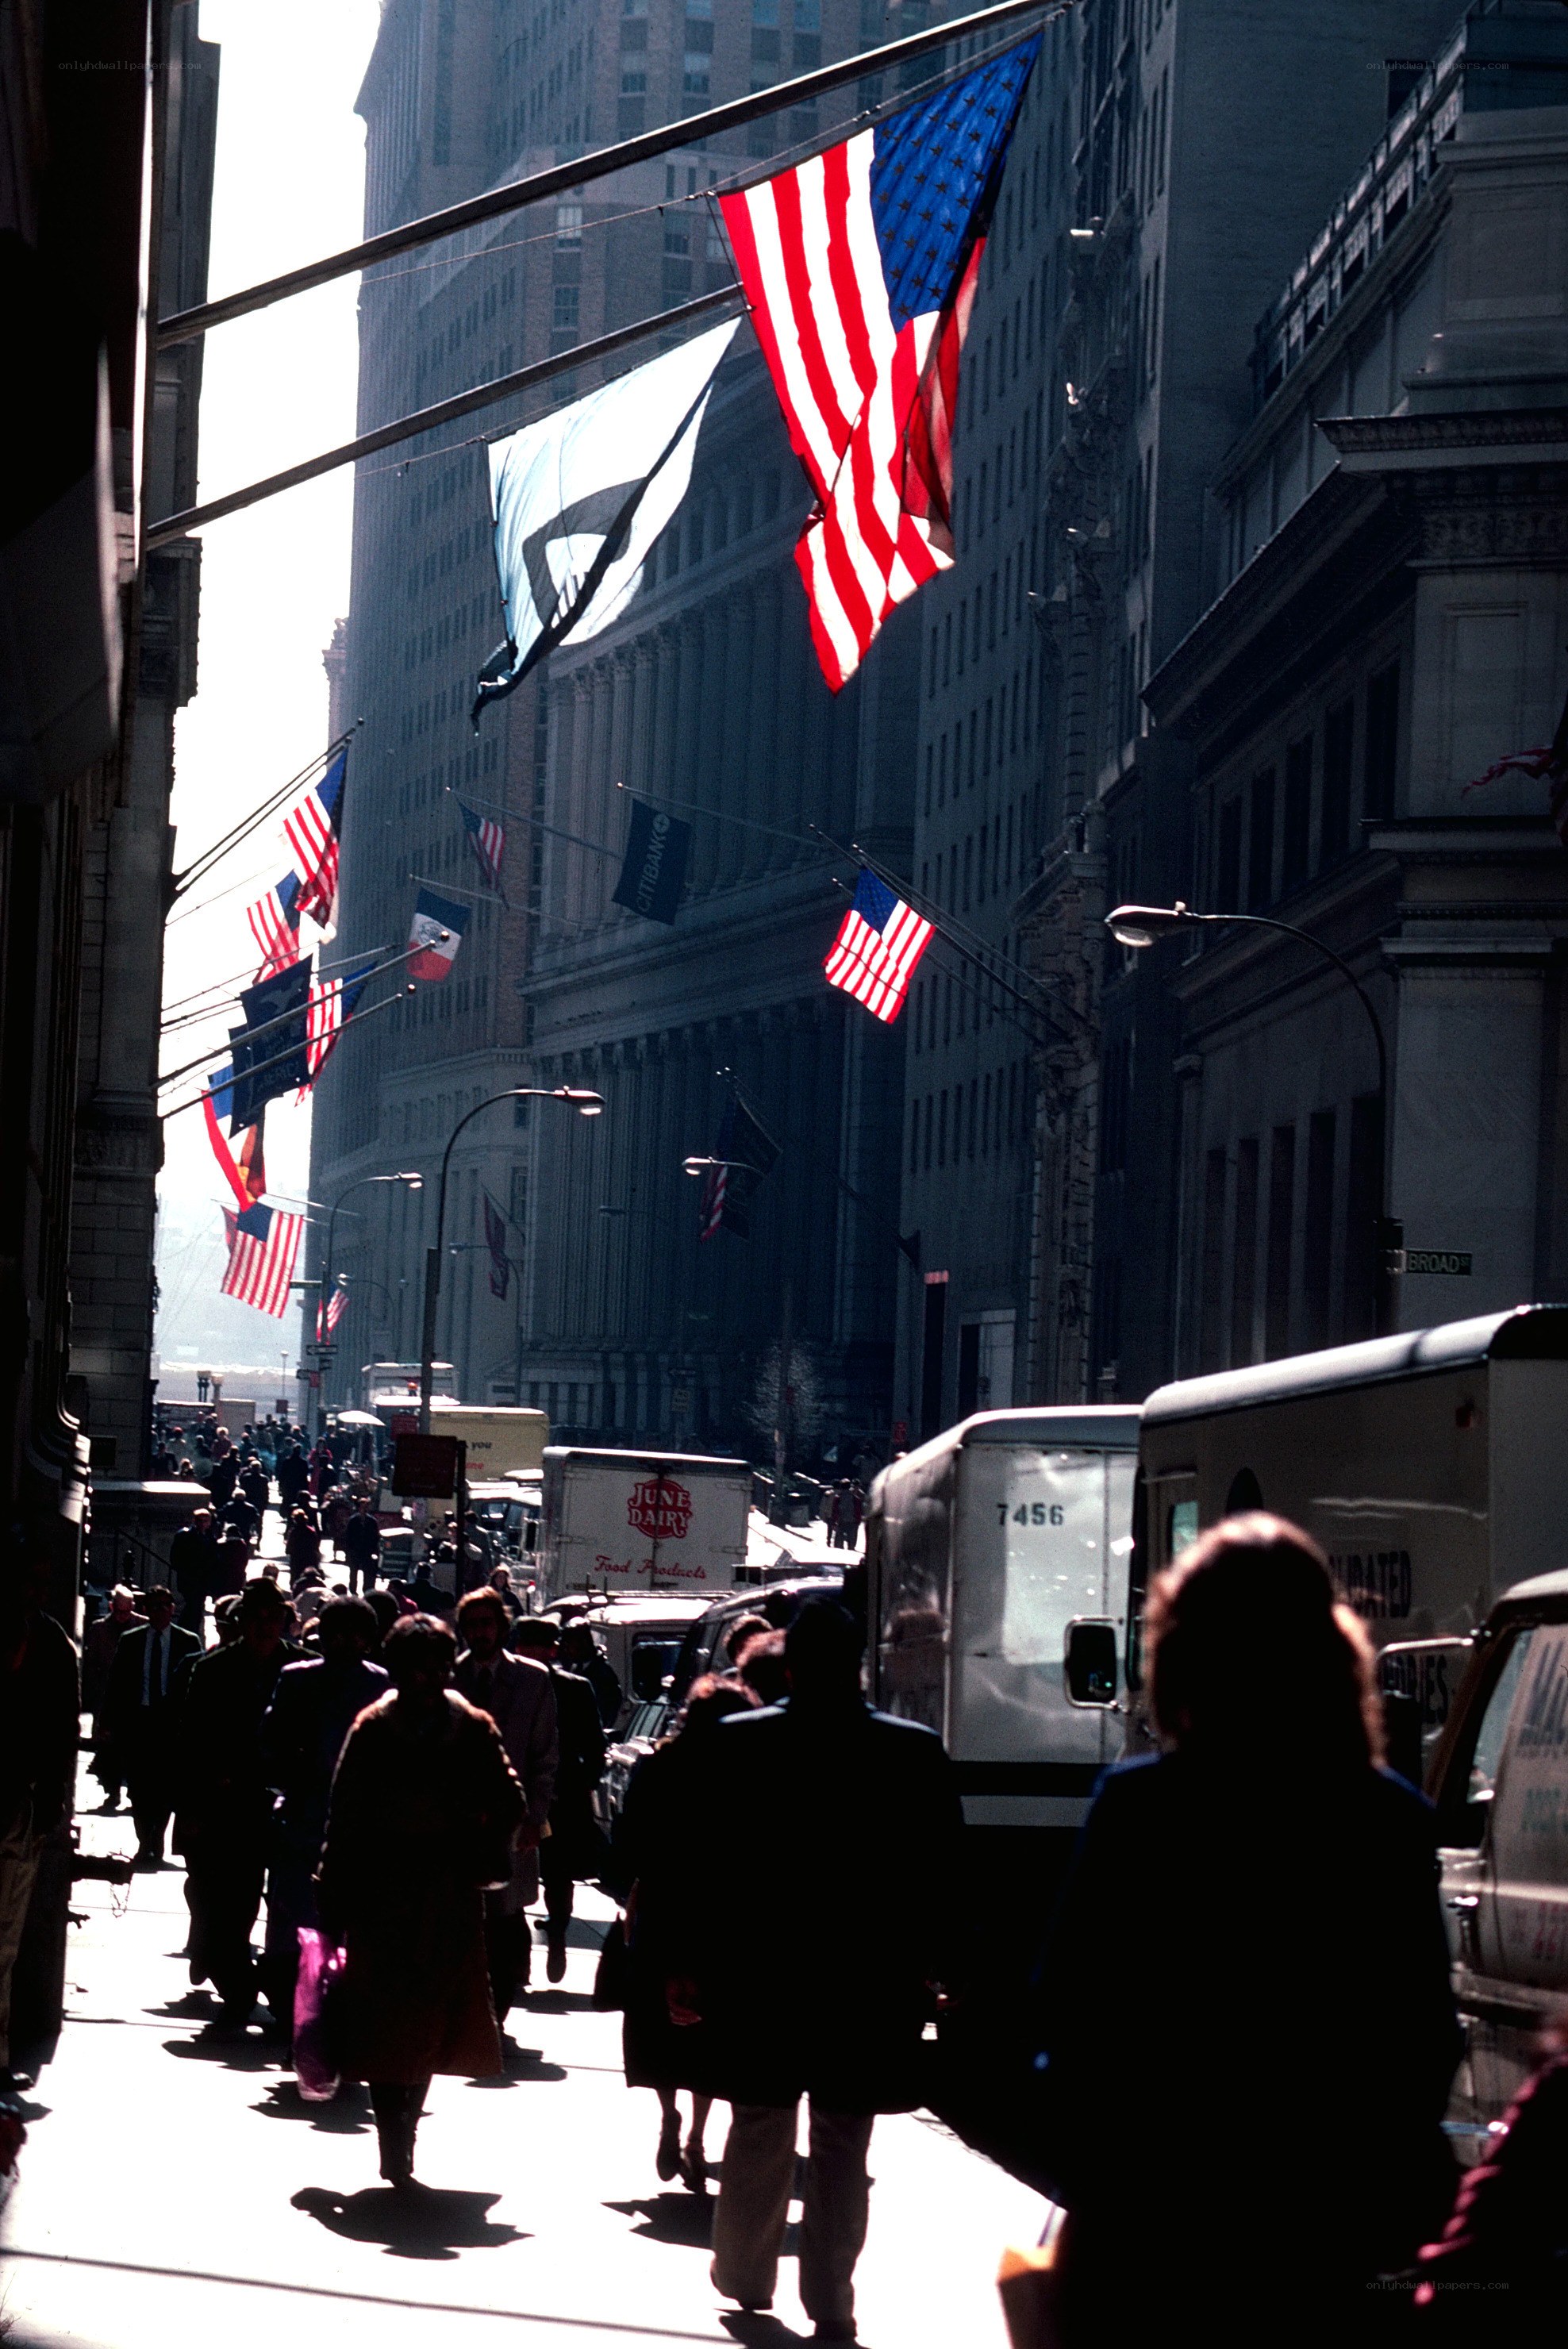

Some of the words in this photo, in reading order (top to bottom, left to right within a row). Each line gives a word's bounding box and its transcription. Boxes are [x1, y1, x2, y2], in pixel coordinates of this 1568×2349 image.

[636, 829, 667, 912] CITIBANK
[1409, 1253, 1460, 1273] BROAD
[628, 1483, 690, 1508] JUNE
[628, 1508, 691, 1538] DAIRY
[997, 1502, 1064, 1525] 7456
[594, 1555, 632, 1574] Food
[637, 1559, 706, 1579] Products
